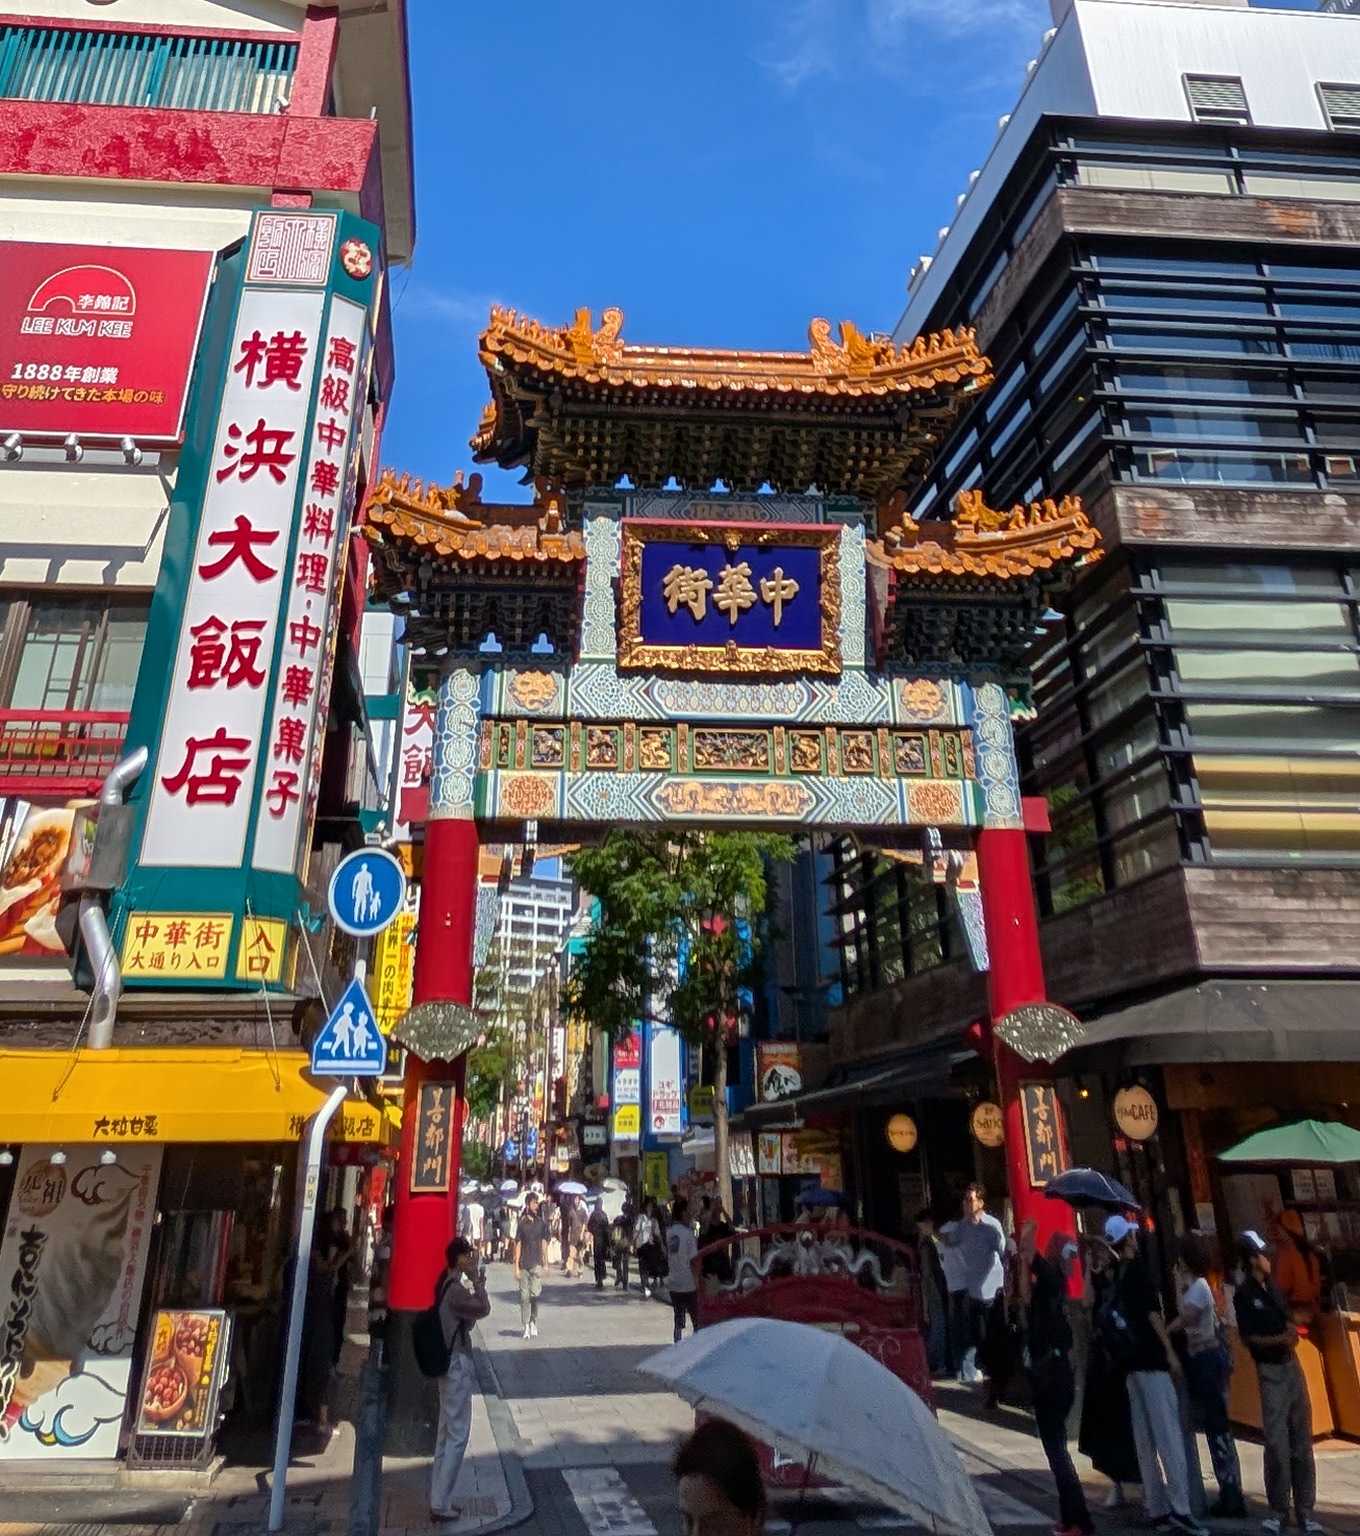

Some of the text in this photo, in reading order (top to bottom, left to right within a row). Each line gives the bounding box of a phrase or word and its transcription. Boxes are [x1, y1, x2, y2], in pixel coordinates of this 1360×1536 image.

[77, 294, 130, 312] 李錦記
[20, 316, 133, 339] LEE KUM KEE
[11, 363, 119, 384] 1888年創業
[162, 331, 308, 809] 横浜大飯店
[264, 336, 357, 818] 高級中華料理・中華菓子
[663, 561, 800, 628] 中華街
[135, 920, 225, 950] 中華街
[129, 951, 220, 971] 大通り入口
[247, 927, 276, 975] 入口
[93, 1115, 159, 1137] 大粒甘栗
